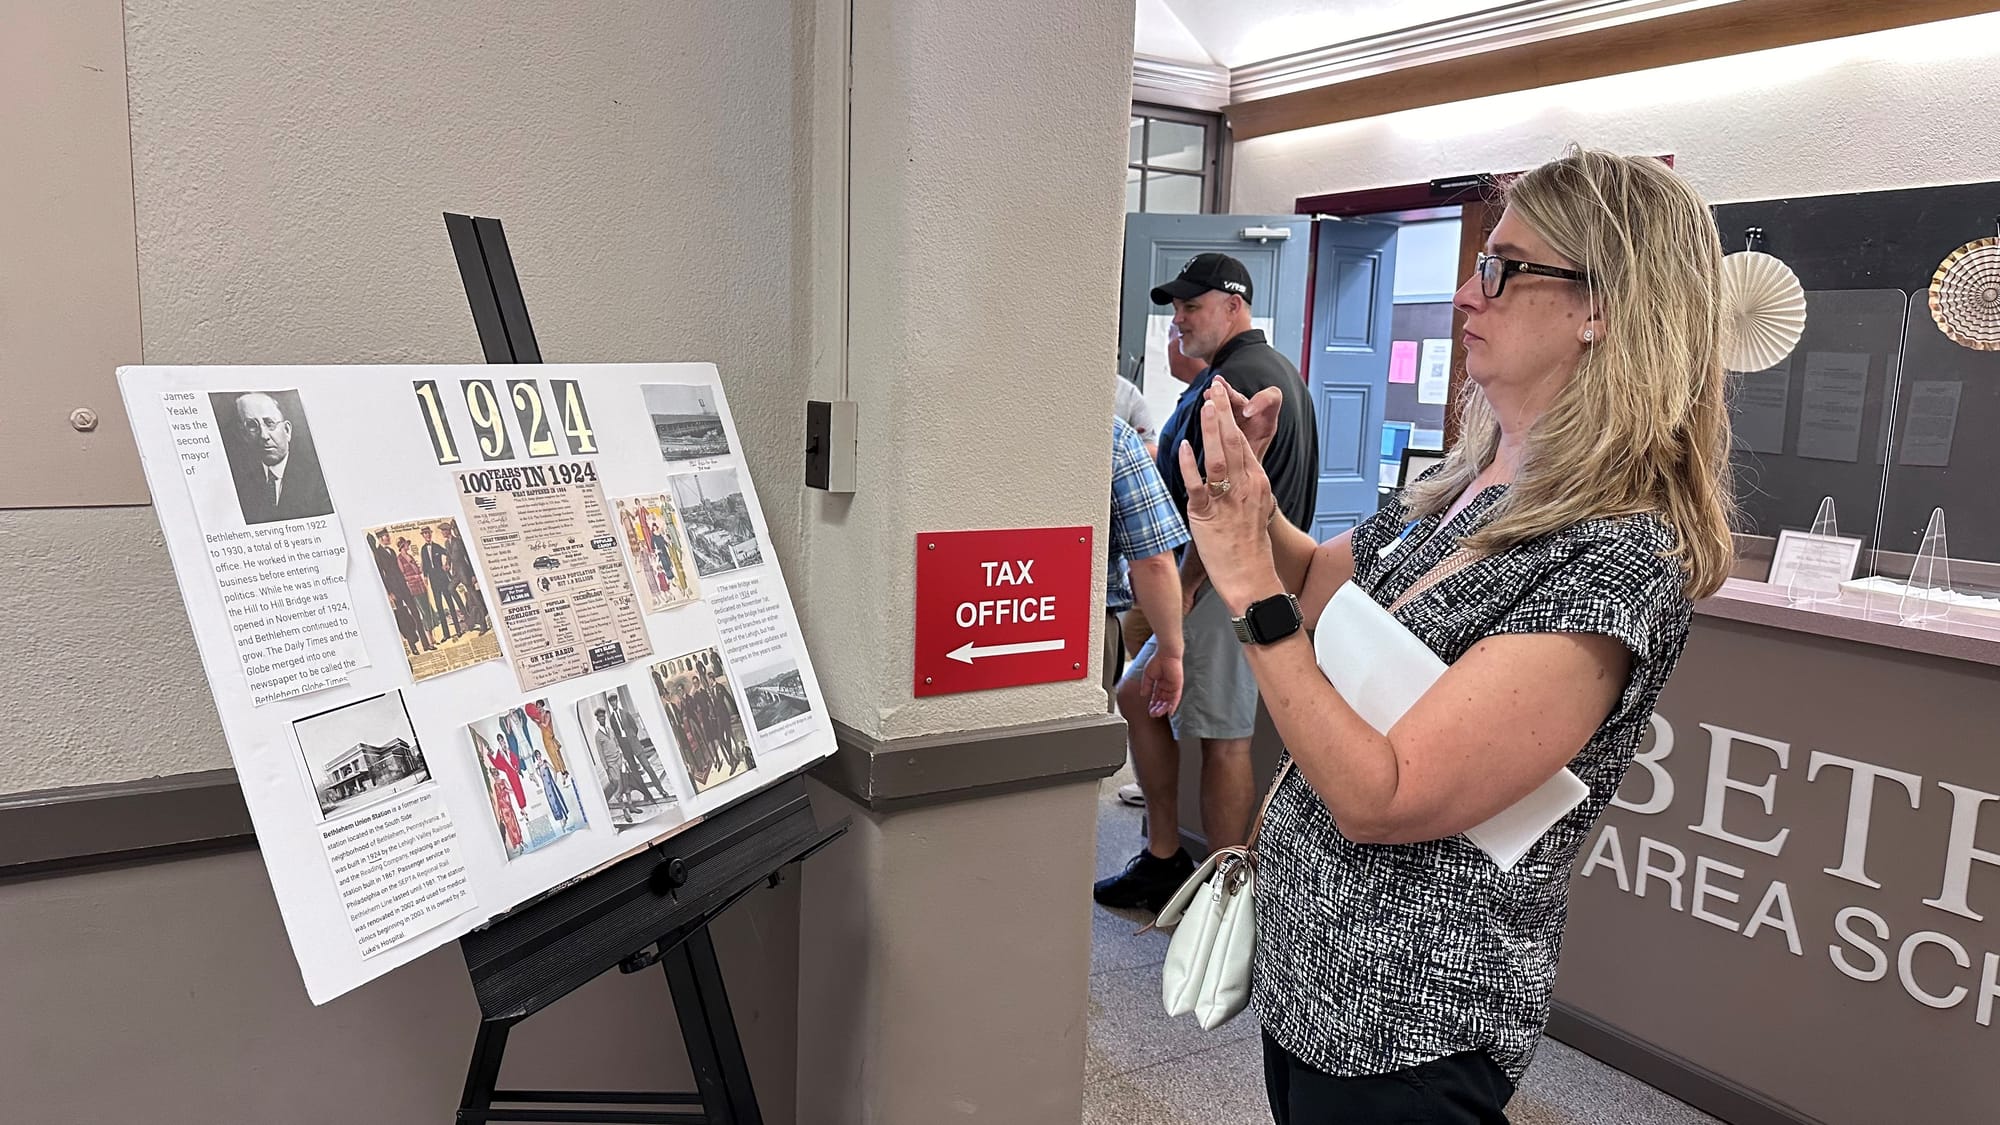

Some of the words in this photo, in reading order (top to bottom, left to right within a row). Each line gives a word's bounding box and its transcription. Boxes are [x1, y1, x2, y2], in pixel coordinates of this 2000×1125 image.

[1224, 281, 1246, 292] VRS
[164, 392, 195, 400] James
[167, 406, 198, 415] Yeakle
[193, 421, 208, 430] the
[416, 381, 597, 463] 1924
[177, 435, 210, 445] second
[181, 452, 209, 461] mayor
[186, 466, 195, 475] of
[487, 467, 521, 480] YEARS
[521, 466, 547, 488] IN
[548, 462, 597, 486] 1924
[460, 472, 492, 493] 100
[495, 478, 522, 492] AGO
[206, 531, 253, 542] Bethlehem,
[254, 527, 284, 536] serving
[285, 524, 304, 532] from
[306, 520, 327, 529] 1922
[221, 545, 245, 555] 1930,
[253, 541, 272, 551] total
[273, 539, 281, 548] of
[290, 538, 312, 548] years
[257, 554, 286, 565] worked
[296, 552, 309, 560] the
[311, 546, 344, 557] carriage
[219, 575, 257, 587] business
[258, 570, 284, 580] before
[286, 566, 319, 576] entering
[568, 569, 596, 578] POPULATION
[980, 560, 1034, 587] TAX
[258, 585, 281, 595] While
[294, 581, 311, 589] was
[228, 608, 241, 616] the
[243, 603, 258, 613] Hill
[270, 598, 284, 608] Hill
[285, 596, 310, 606] Bridge
[505, 609, 540, 621] HIGHLIGHTS
[508, 605, 531, 614] SPORTS
[956, 596, 1056, 628] OFFICE
[233, 618, 264, 632] opened
[275, 609, 315, 622] November
[317, 605, 325, 614] of
[327, 602, 349, 612] 1924,
[238, 635, 253, 646] and
[254, 628, 300, 642] Bethlehem
[301, 618, 338, 632] continued
[265, 646, 282, 654] The
[284, 640, 304, 651] Daily
[305, 636, 328, 646] Times
[329, 631, 343, 641] and
[555, 647, 574, 656] RADIO
[246, 664, 269, 675] Globe
[271, 655, 304, 669] merged
[250, 673, 296, 690] newspaper
[320, 661, 342, 673] called
[343, 659, 355, 668] the
[323, 823, 354, 838] Bethlehem
[354, 817, 370, 826] Union
[371, 809, 391, 819] Station
[327, 839, 346, 850] station
[347, 830, 368, 841] located
[384, 818, 400, 827] South
[331, 842, 369, 862] neighborhood
[347, 859, 359, 868] built
[366, 850, 380, 860] 1924
[339, 876, 349, 885] and
[360, 863, 382, 876] Reading
[343, 885, 362, 897] station
[362, 879, 374, 888] built
[397, 858, 424, 873] Passenger
[346, 891, 380, 908] Philadelphia
[397, 874, 416, 886] SEPTA
[1580, 825, 1803, 956] AREA
[350, 904, 380, 921] Bethlehem
[380, 899, 391, 907] Line
[392, 890, 409, 901] lasted
[354, 924, 366, 932] was
[367, 910, 394, 926] renovated
[400, 900, 414, 911] 2002
[415, 895, 425, 904] and
[358, 932, 376, 944] clinics
[376, 919, 404, 935] beginning
[362, 944, 380, 956] Luke's
